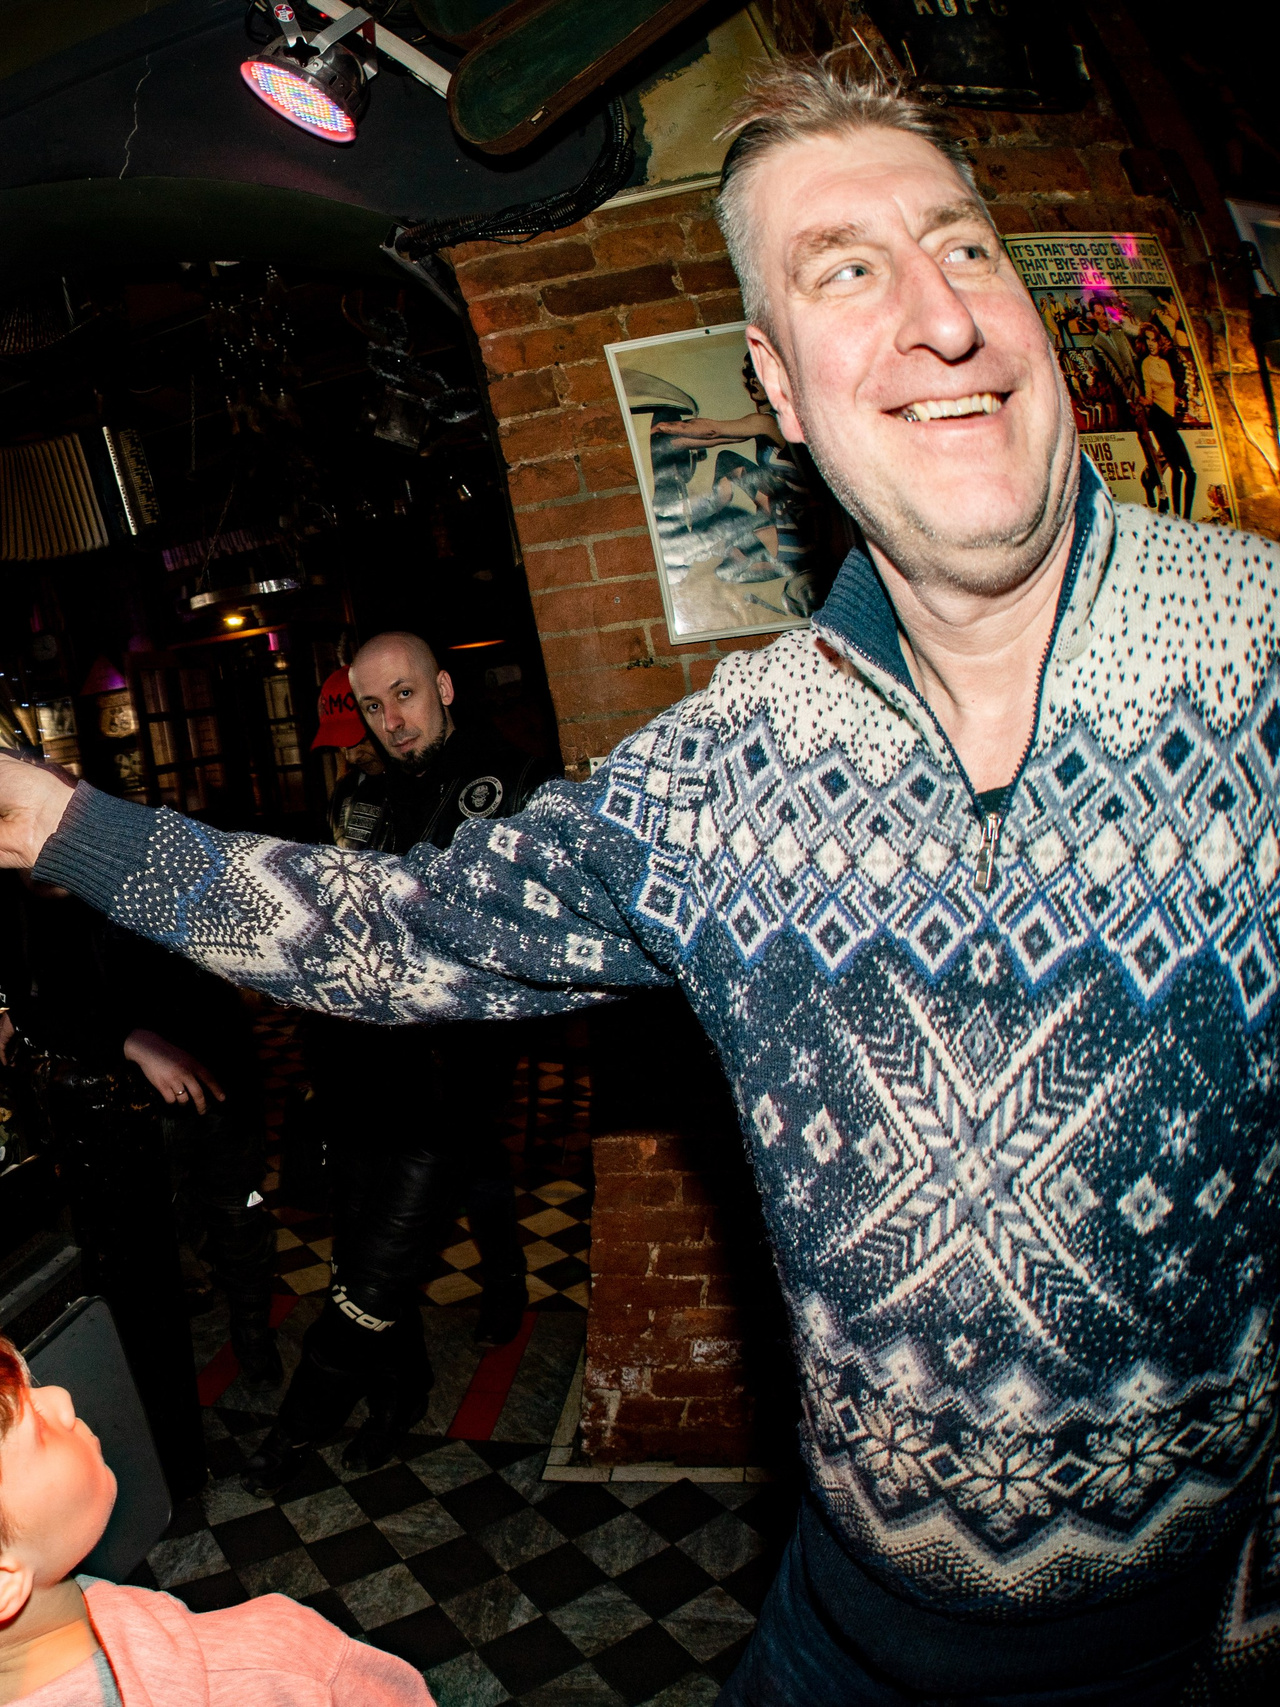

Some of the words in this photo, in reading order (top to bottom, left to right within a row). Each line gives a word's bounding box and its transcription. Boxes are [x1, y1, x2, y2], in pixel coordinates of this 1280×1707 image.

[1011, 243, 1034, 258] IT'S
[1035, 243, 1066, 258] THAT
[1110, 242, 1133, 257] GUY
[1136, 243, 1160, 257] AND
[1017, 258, 1049, 272] THAT
[1106, 257, 1130, 271] GAL
[1130, 257, 1142, 270] IN
[1142, 257, 1166, 270] THE
[1022, 273, 1048, 287] FUN
[1050, 272, 1093, 286] CAPITAL
[1092, 272, 1106, 285] OF
[1107, 271, 1128, 285] THE
[1080, 442, 1113, 462] LVIS
[1095, 461, 1136, 481] ESLEY
